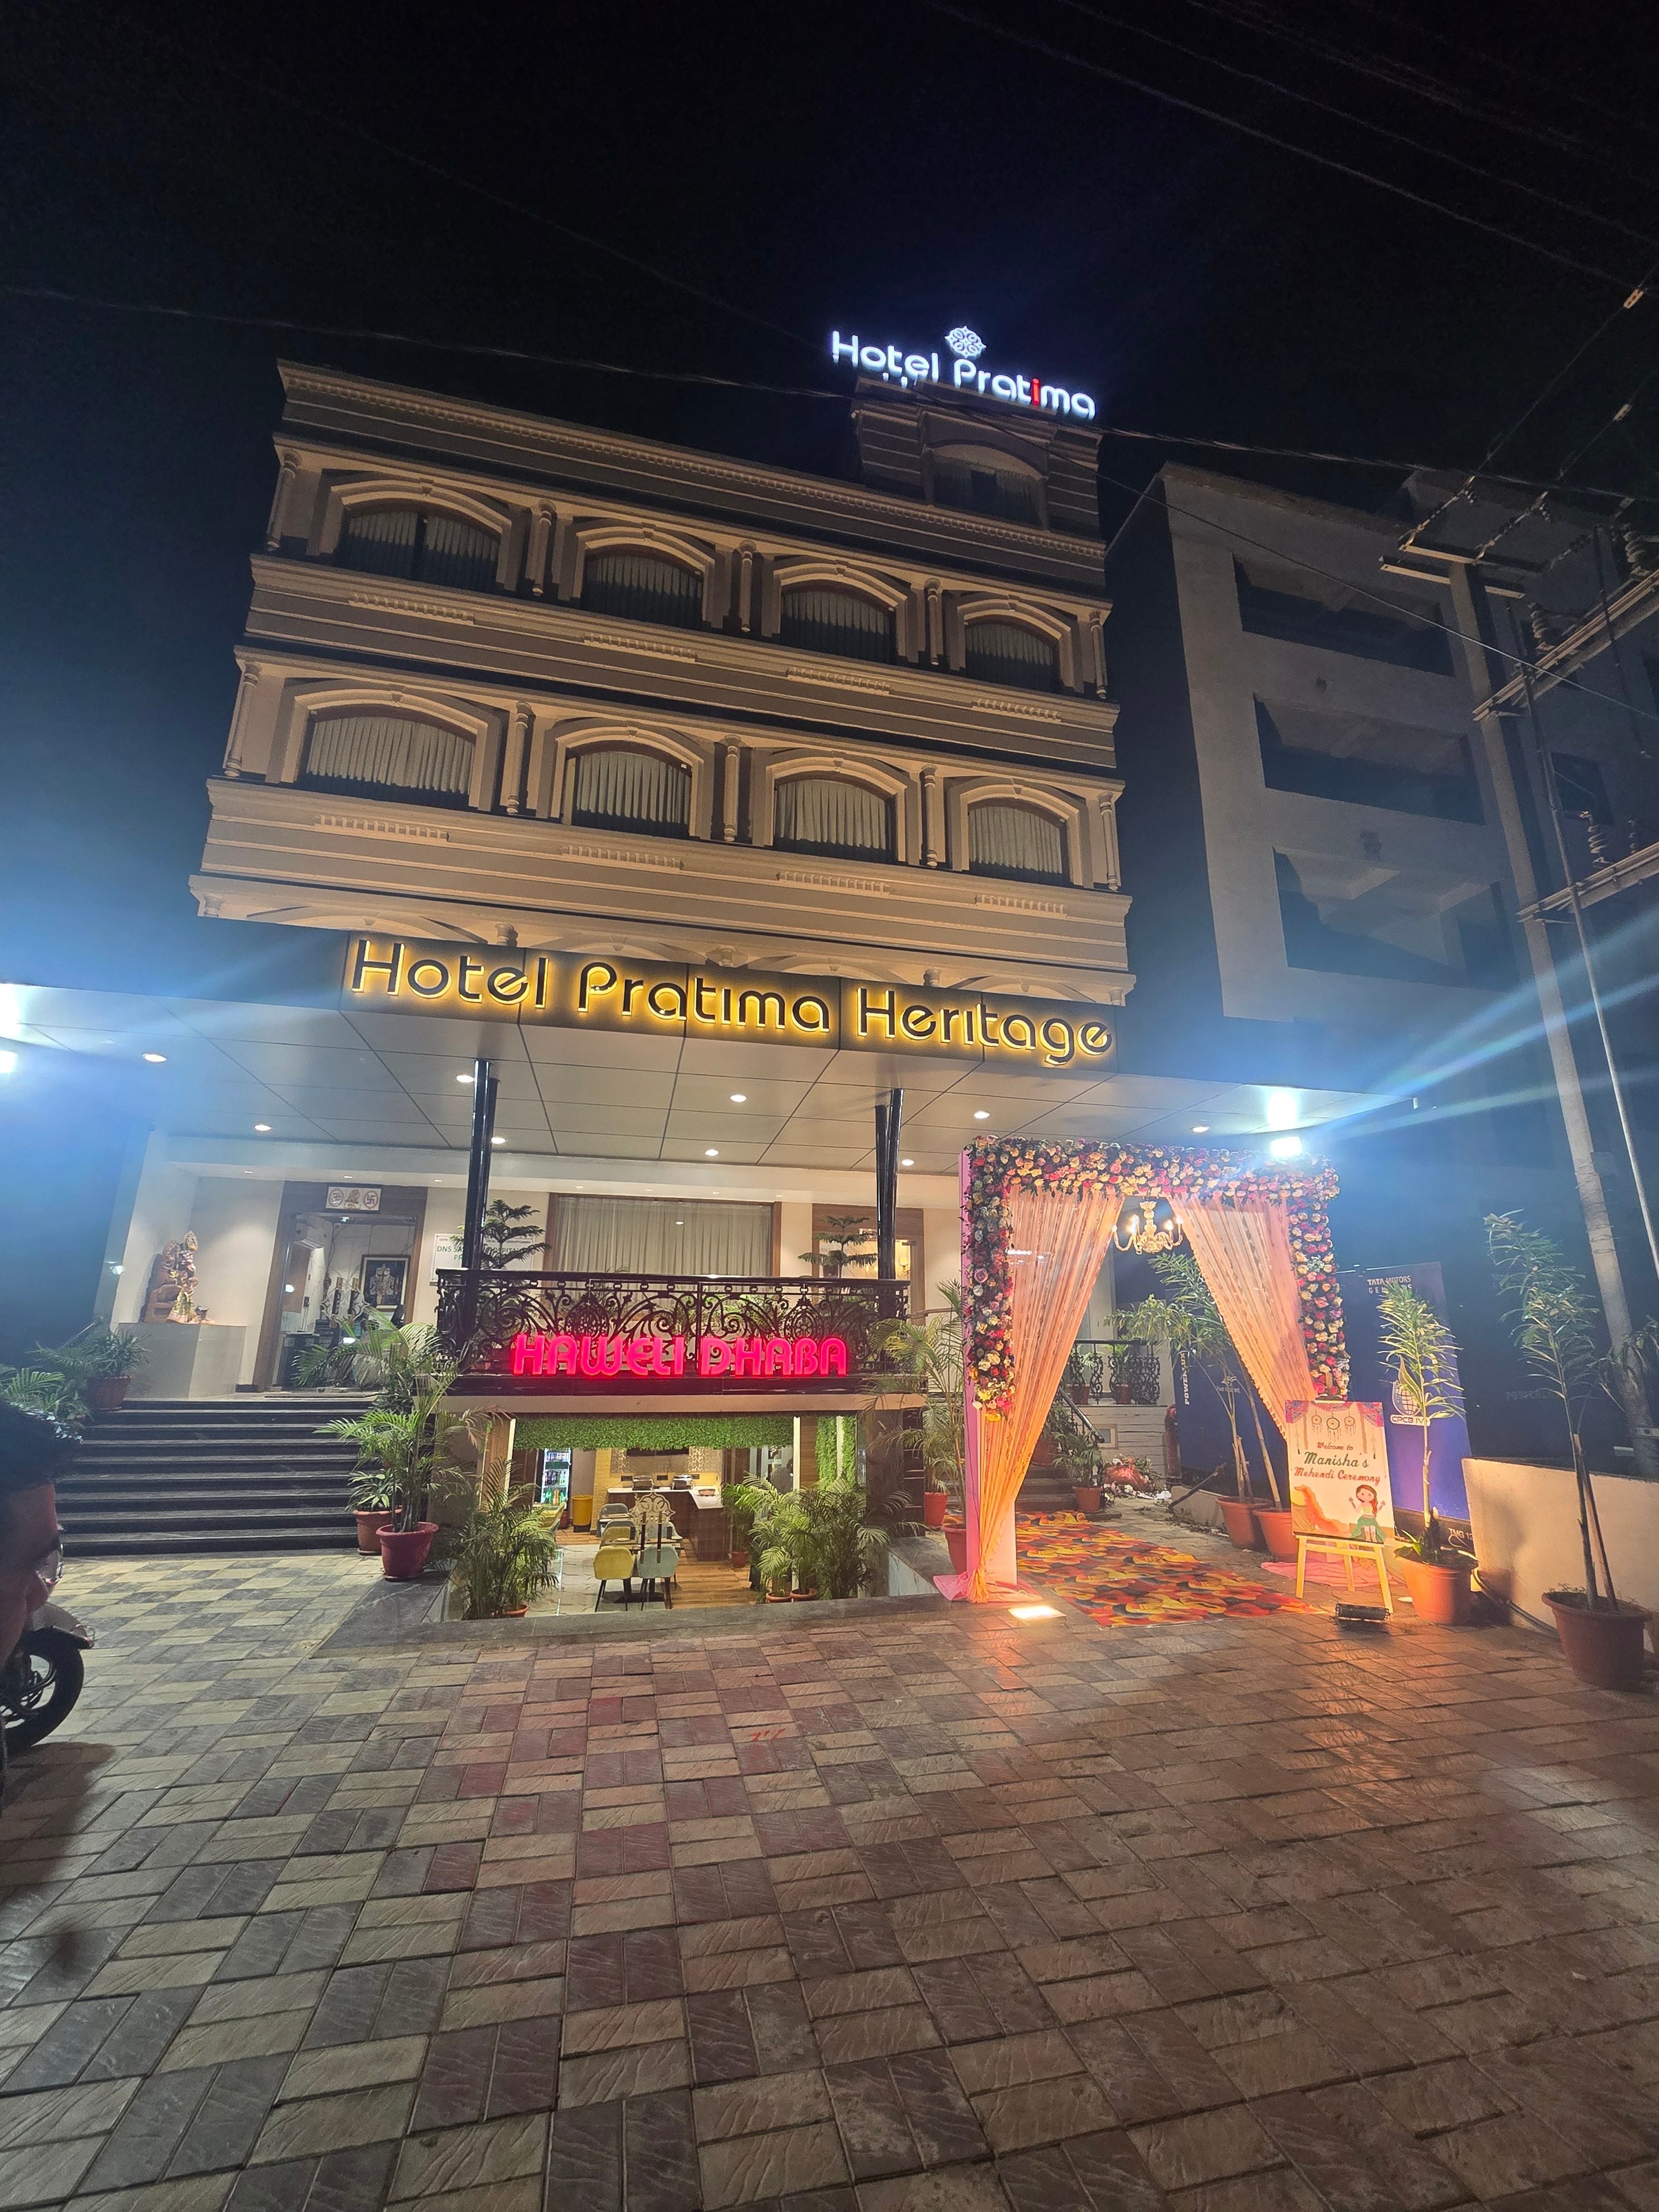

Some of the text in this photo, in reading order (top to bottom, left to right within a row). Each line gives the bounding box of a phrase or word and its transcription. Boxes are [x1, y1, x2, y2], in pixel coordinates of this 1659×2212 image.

[832, 331, 1095, 420] Hotel Pratima
[351, 939, 1112, 1065] Hotel Pratima Heritage
[1386, 1275, 1411, 1284] MOTORS
[513, 1335, 848, 1376] HAWELI DHABA
[1317, 1442, 1344, 1451] Welcome
[1304, 1451, 1370, 1468] Manisha's
[1294, 1467, 1381, 1486] Mehendi Ceremony
[1448, 1527, 1465, 1538] TMG
